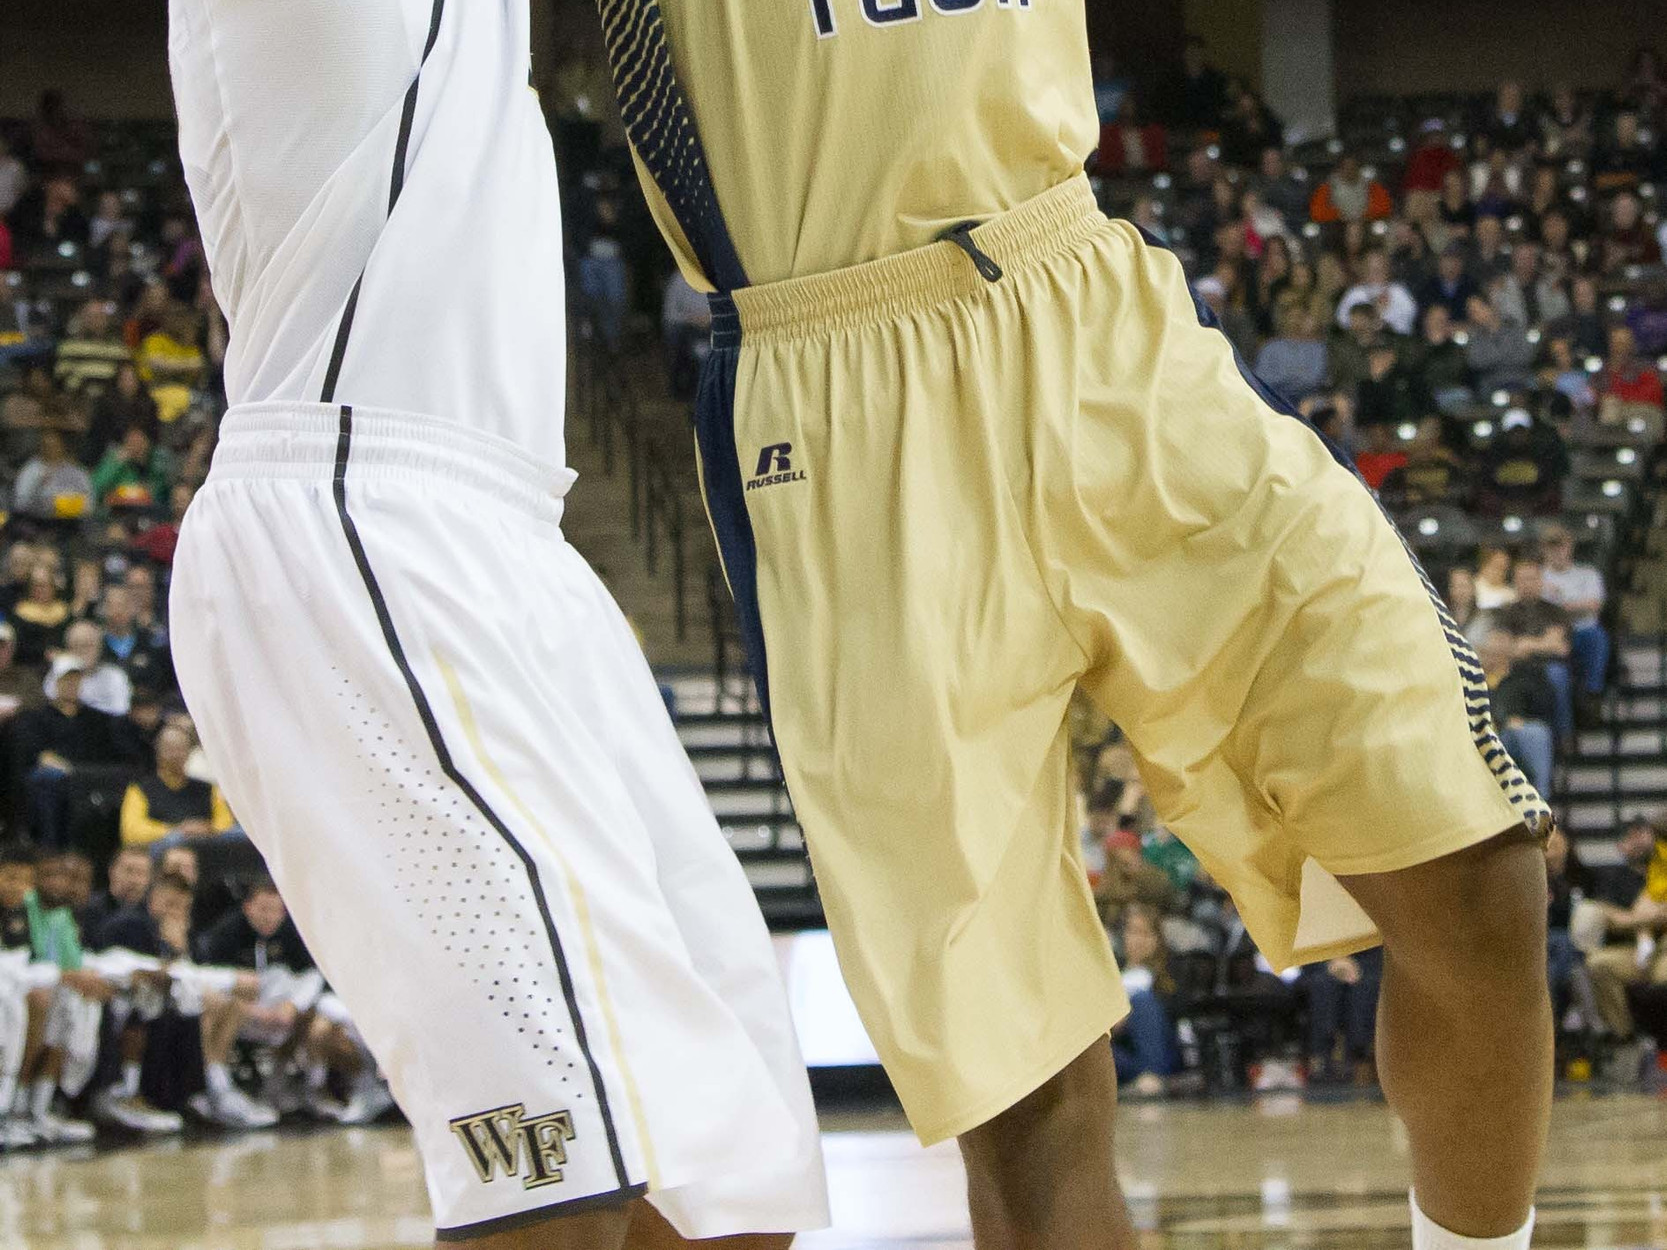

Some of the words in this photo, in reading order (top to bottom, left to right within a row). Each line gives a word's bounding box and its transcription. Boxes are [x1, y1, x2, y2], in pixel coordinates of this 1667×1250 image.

[755, 442, 792, 477] R
[746, 470, 807, 491] RUSSELL
[449, 1102, 576, 1190] WF
